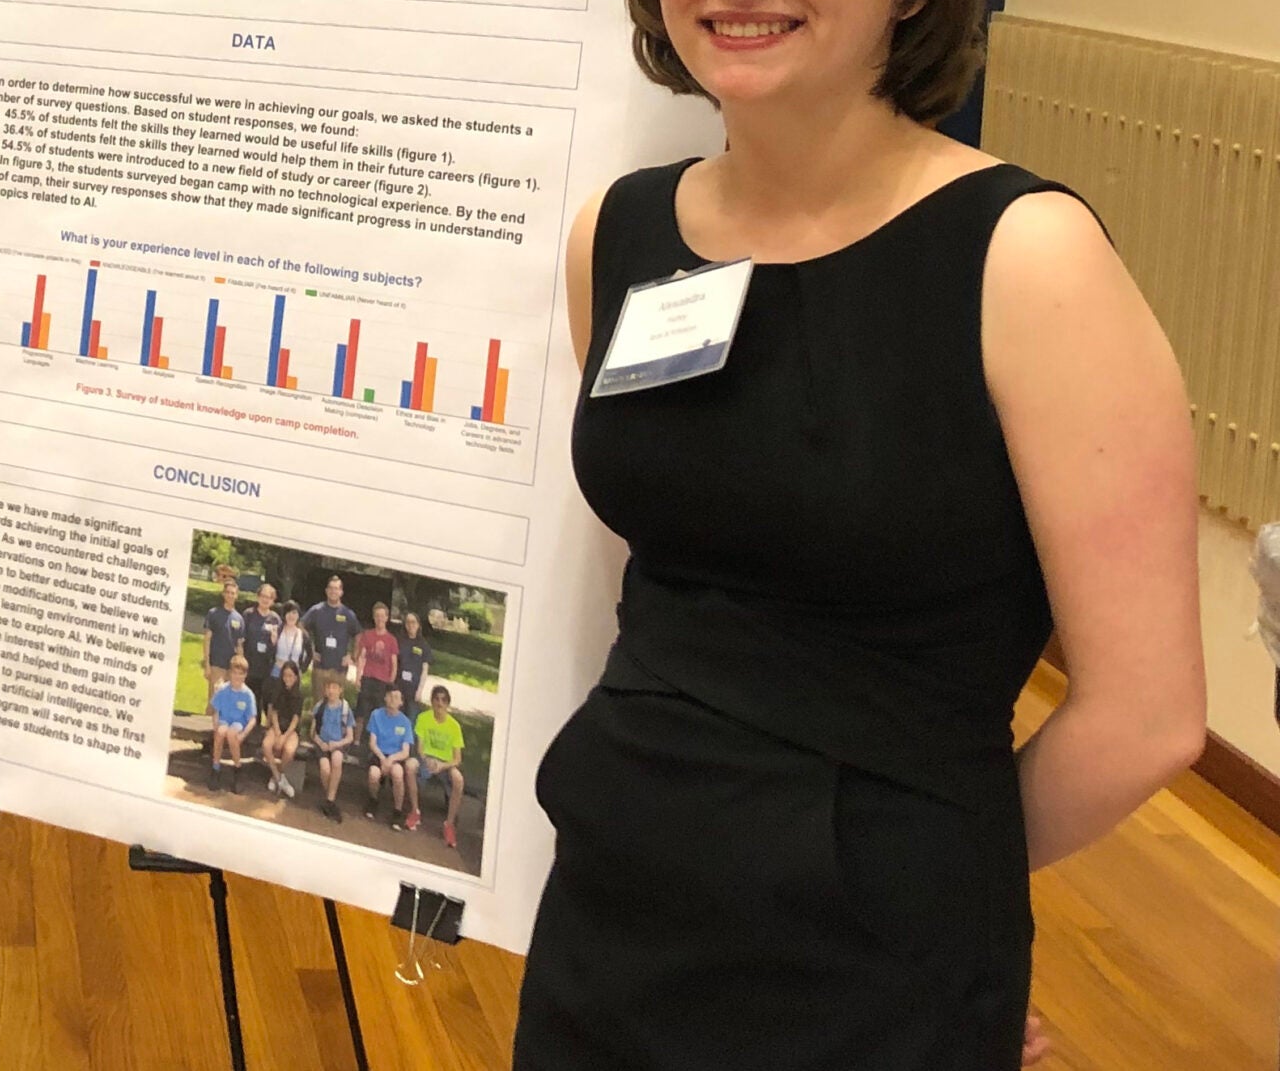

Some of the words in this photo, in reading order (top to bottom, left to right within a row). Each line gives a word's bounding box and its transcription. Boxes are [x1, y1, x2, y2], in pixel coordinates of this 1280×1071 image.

[231, 33, 276, 51] DATA
[4, 108, 36, 121] 45.5%
[38, 111, 50, 122] of
[51, 113, 98, 128] students
[101, 117, 118, 130] felt
[120, 119, 138, 132] the
[140, 122, 169, 135] skills
[172, 125, 197, 140] they
[199, 127, 242, 142] learned
[244, 134, 280, 146] would
[282, 135, 297, 148] be
[300, 139, 337, 152] useful
[340, 141, 359, 154] life
[361, 144, 393, 158] skills
[396, 147, 437, 163] (figure
[441, 151, 455, 166] 1).
[31, 190, 68, 204] related
[70, 194, 81, 206] to
[82, 195, 96, 207] AI.
[60, 229, 88, 244] What
[90, 233, 100, 246] is
[101, 237, 128, 250] your
[130, 241, 191, 258] experience
[193, 247, 221, 262] level
[222, 250, 234, 263] in
[236, 255, 265, 268] each
[267, 257, 281, 269] of
[282, 259, 301, 272] the
[304, 261, 359, 283] following
[362, 271, 423, 288] subjects?
[75, 382, 104, 396] Figure
[115, 388, 147, 404] Survey
[148, 394, 159, 404] of
[159, 397, 195, 411] student
[196, 401, 247, 421] knowledge
[248, 413, 273, 424] upon
[274, 417, 301, 431] camp
[153, 464, 261, 498] CONCLUSION
[6, 502, 21, 513] we
[23, 503, 49, 519] have
[50, 511, 82, 525] made
[83, 516, 142, 537] significant
